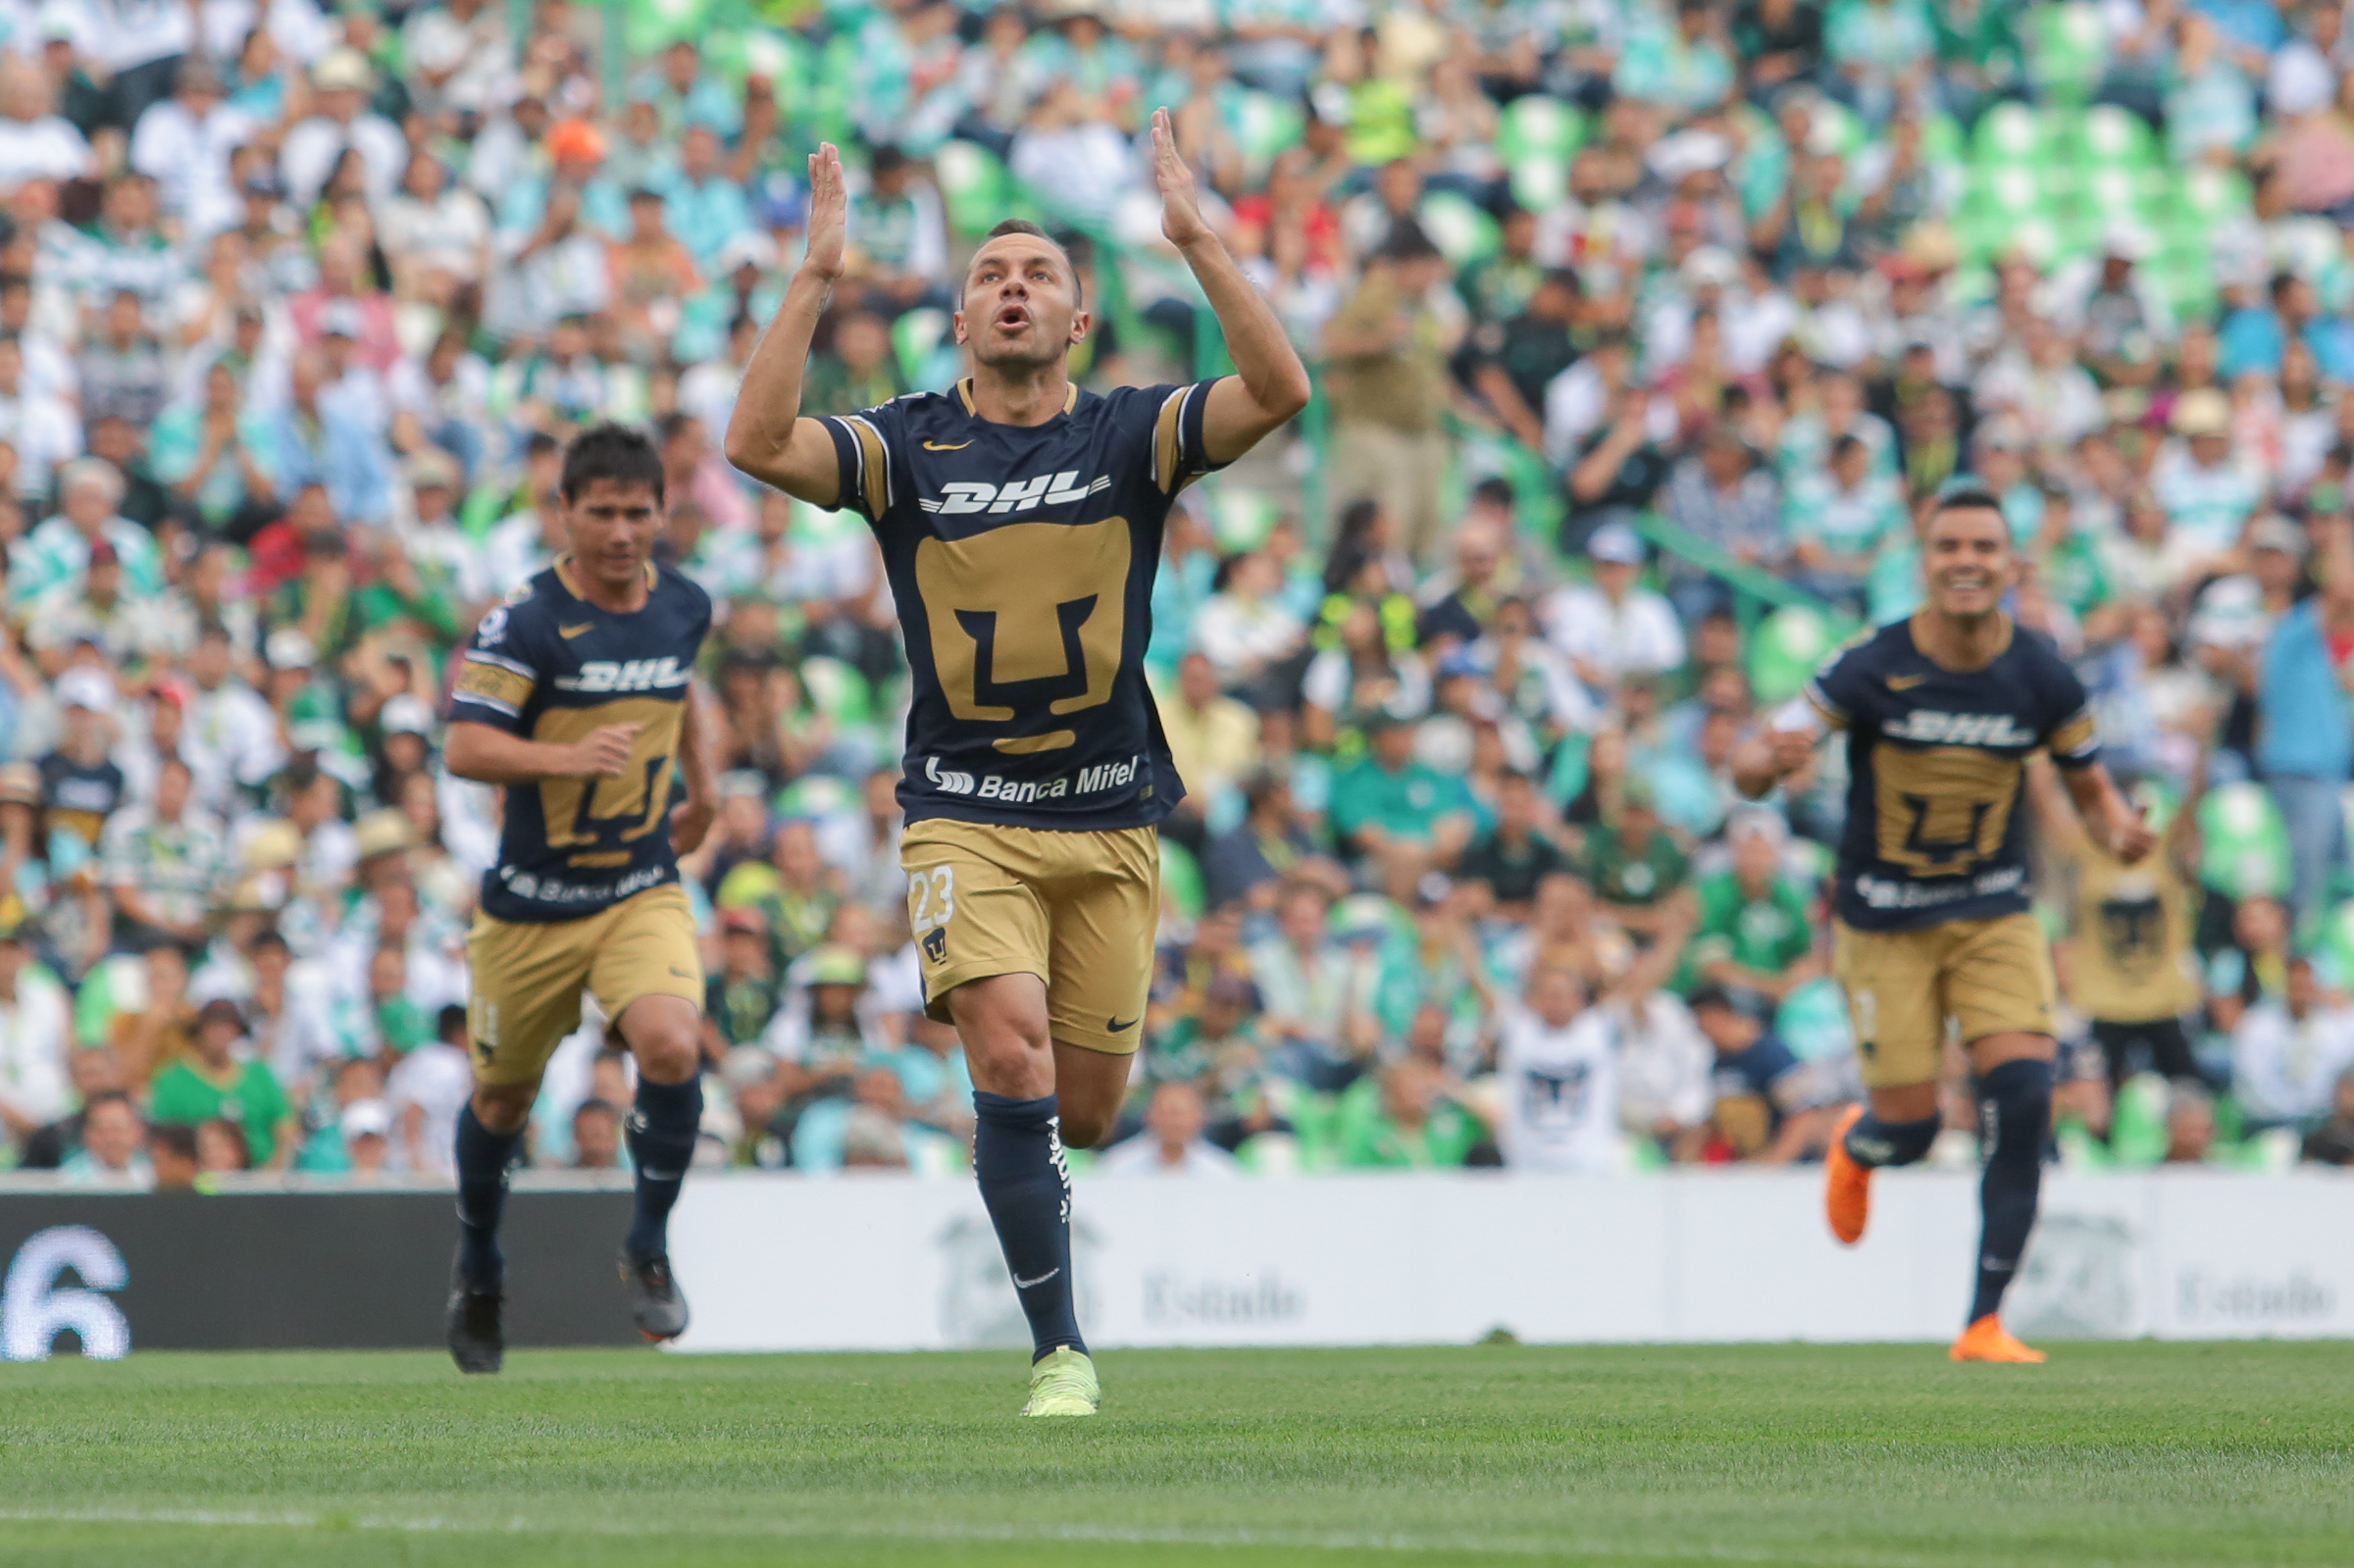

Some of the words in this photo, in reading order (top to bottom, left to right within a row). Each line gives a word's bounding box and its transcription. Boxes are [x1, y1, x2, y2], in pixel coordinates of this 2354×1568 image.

[939, 470, 1090, 514] DHL
[579, 655, 692, 692] DHL
[1907, 709, 2019, 746] DHL
[977, 775, 1068, 802] Banca
[1075, 755, 1138, 794] Mifel
[909, 865, 954, 934] 23
